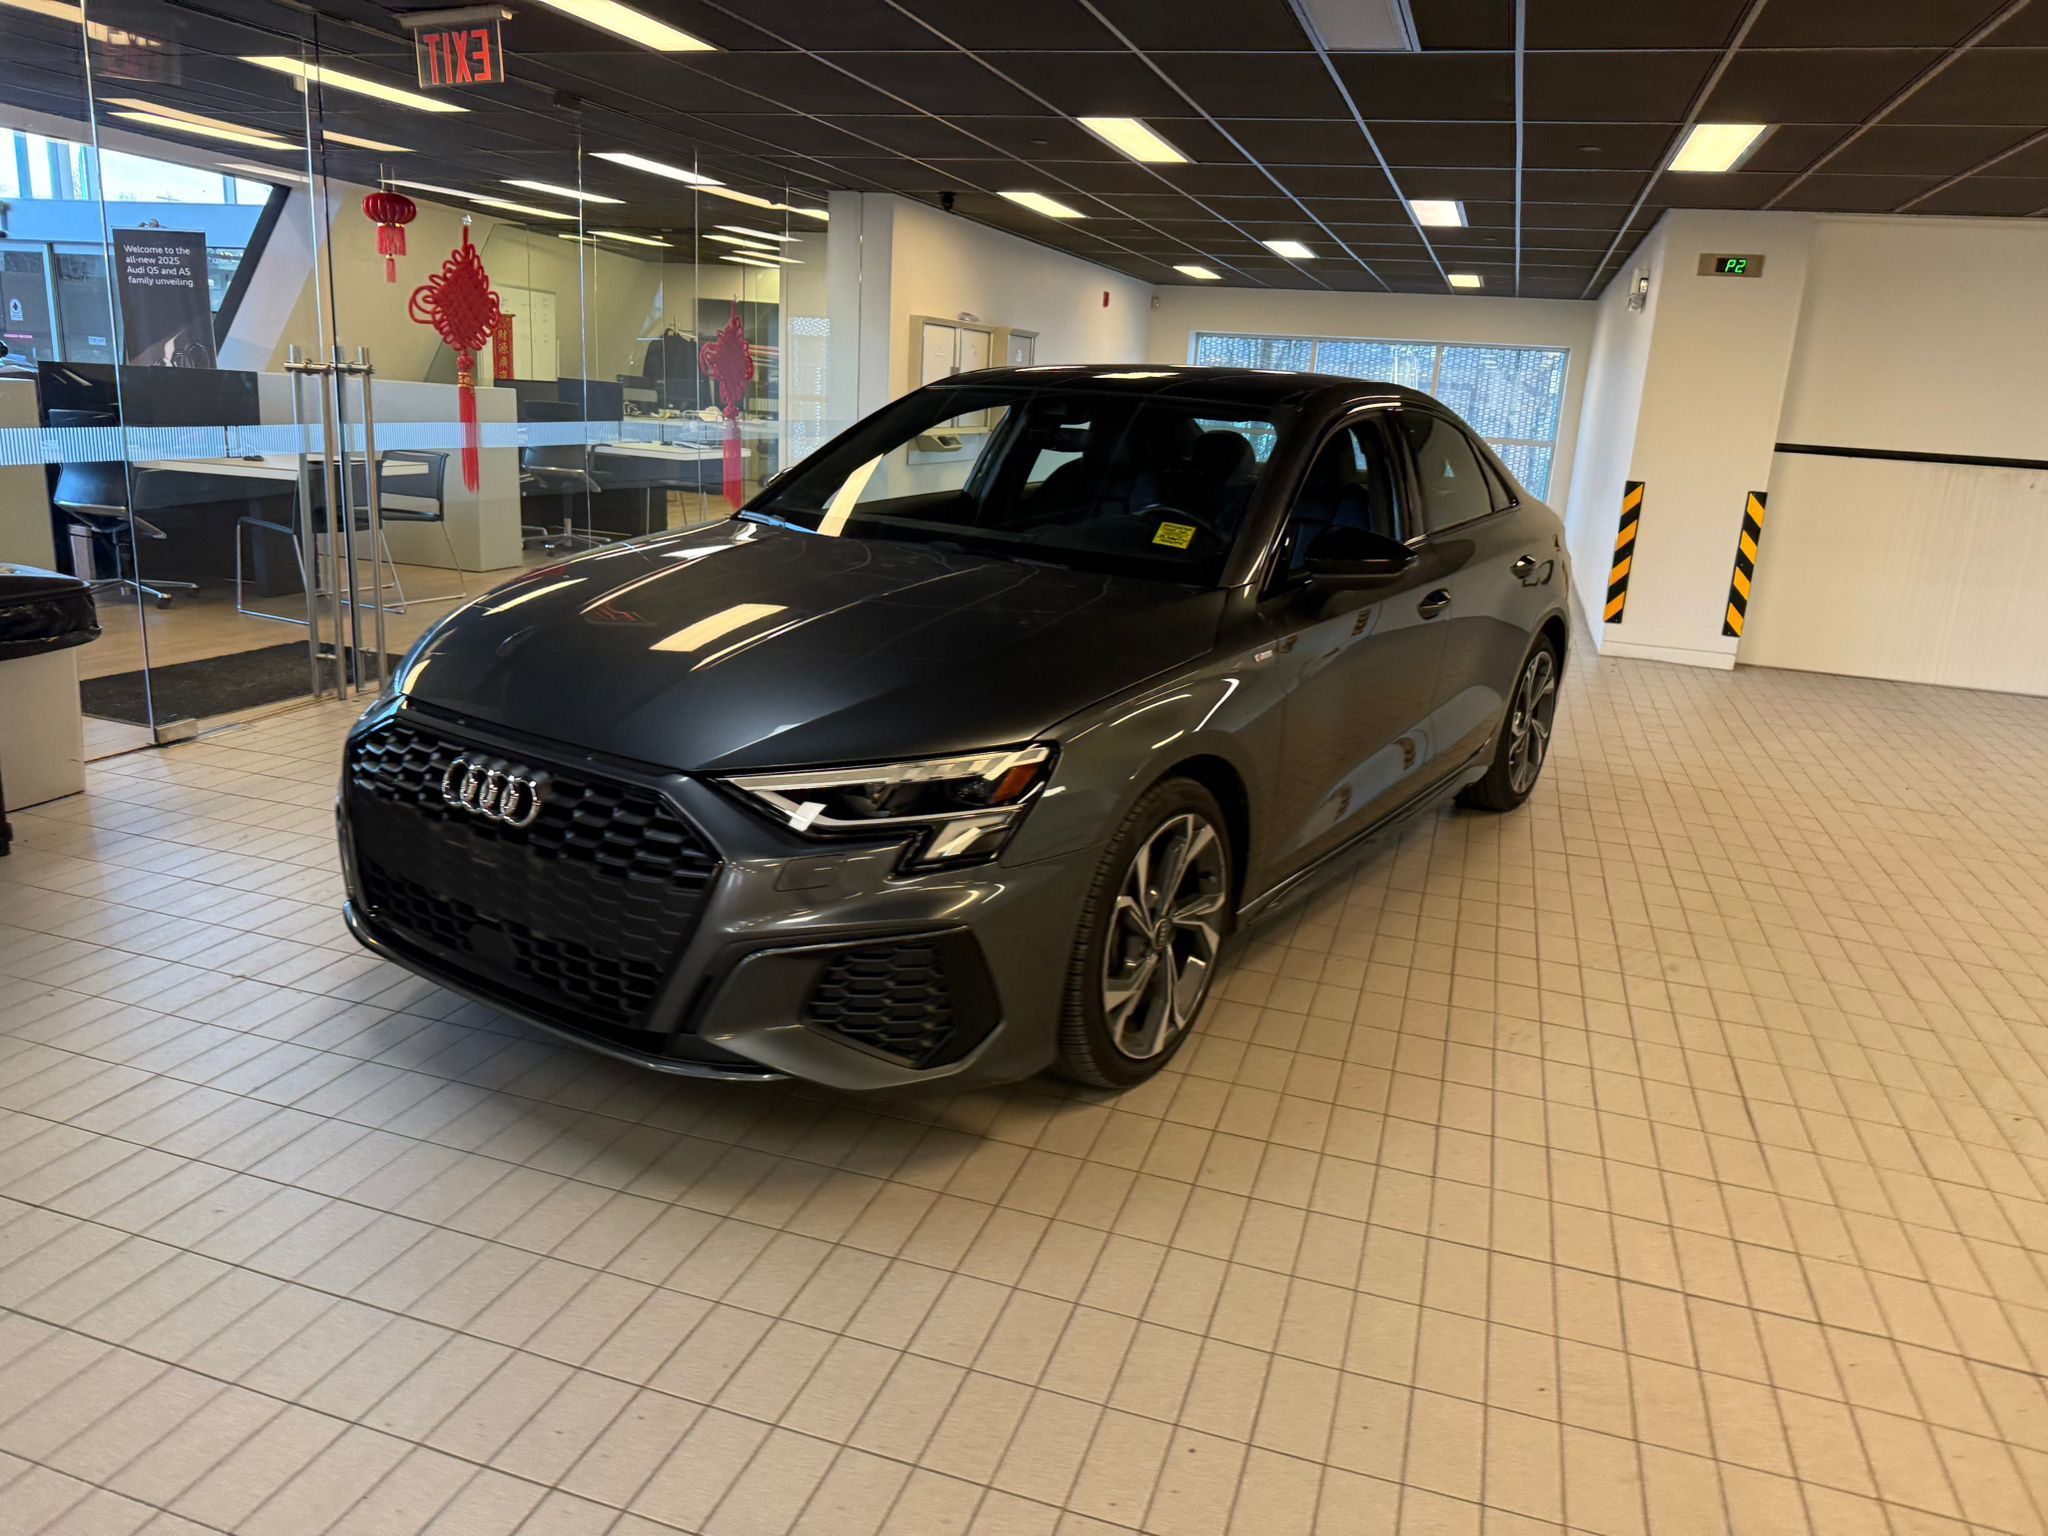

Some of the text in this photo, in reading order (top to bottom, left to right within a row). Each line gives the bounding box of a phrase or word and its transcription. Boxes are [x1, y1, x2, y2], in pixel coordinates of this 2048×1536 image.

[123, 245, 163, 254] Welcome
[175, 247, 190, 255] the
[125, 256, 180, 265] all-new 2025
[1725, 259, 1747, 273] P2
[127, 265, 191, 276] Audi Q5 and A5
[128, 276, 194, 288] family unveiling
